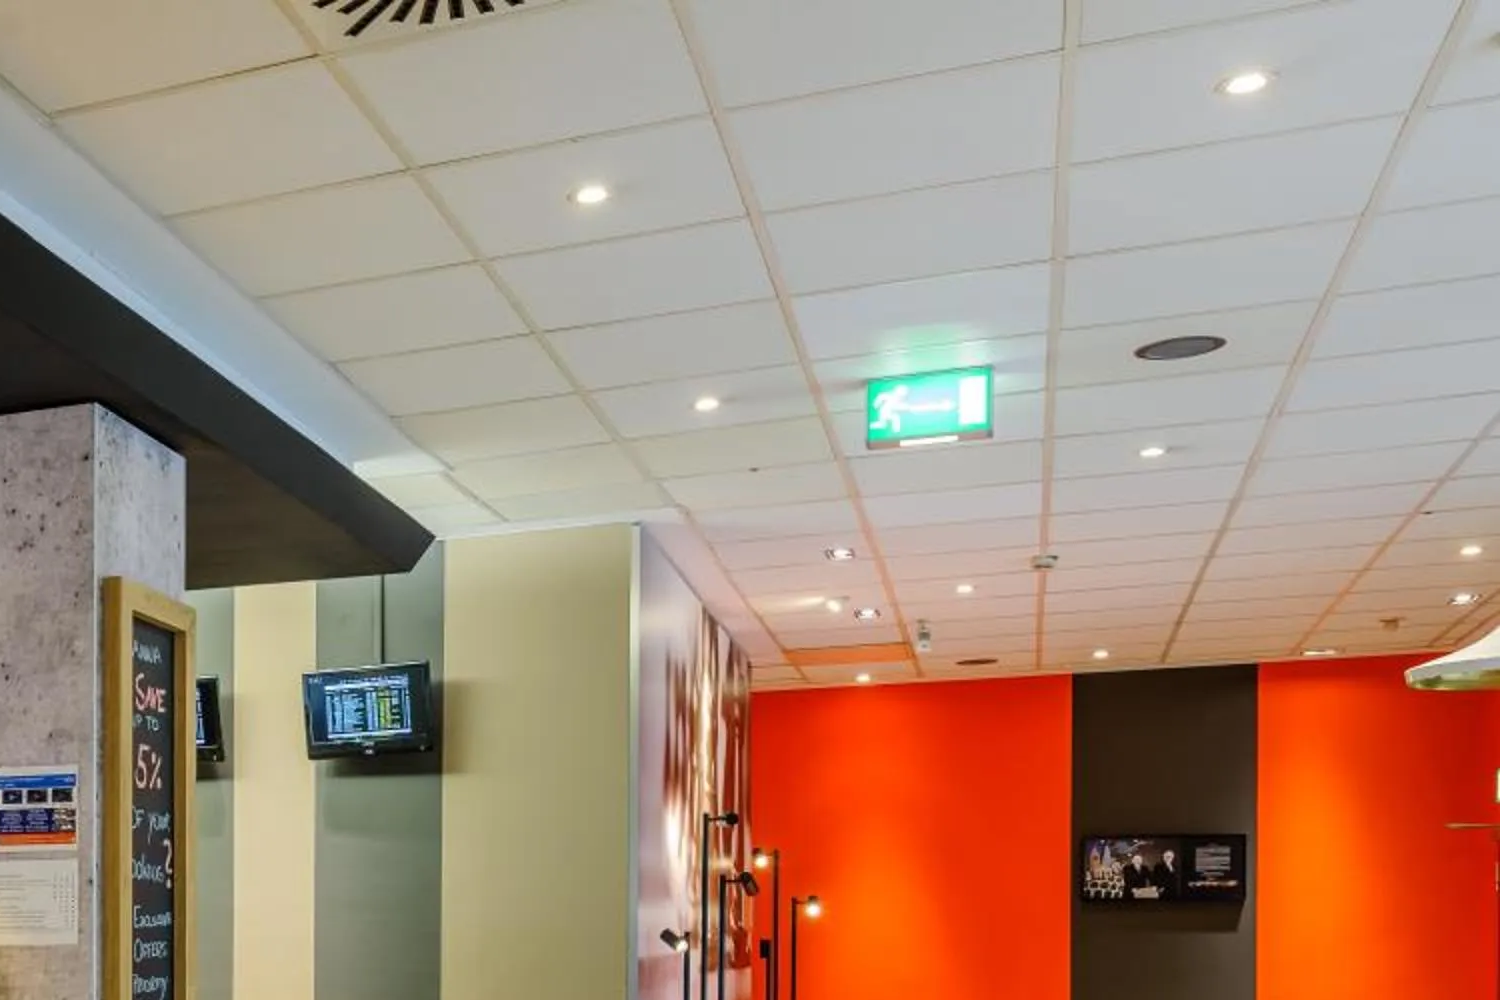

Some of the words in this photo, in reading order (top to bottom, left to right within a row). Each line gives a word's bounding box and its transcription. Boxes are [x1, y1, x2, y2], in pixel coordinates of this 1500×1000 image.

[132, 714, 143, 727] P
[144, 715, 160, 731] TO
[135, 743, 163, 790] 5%
